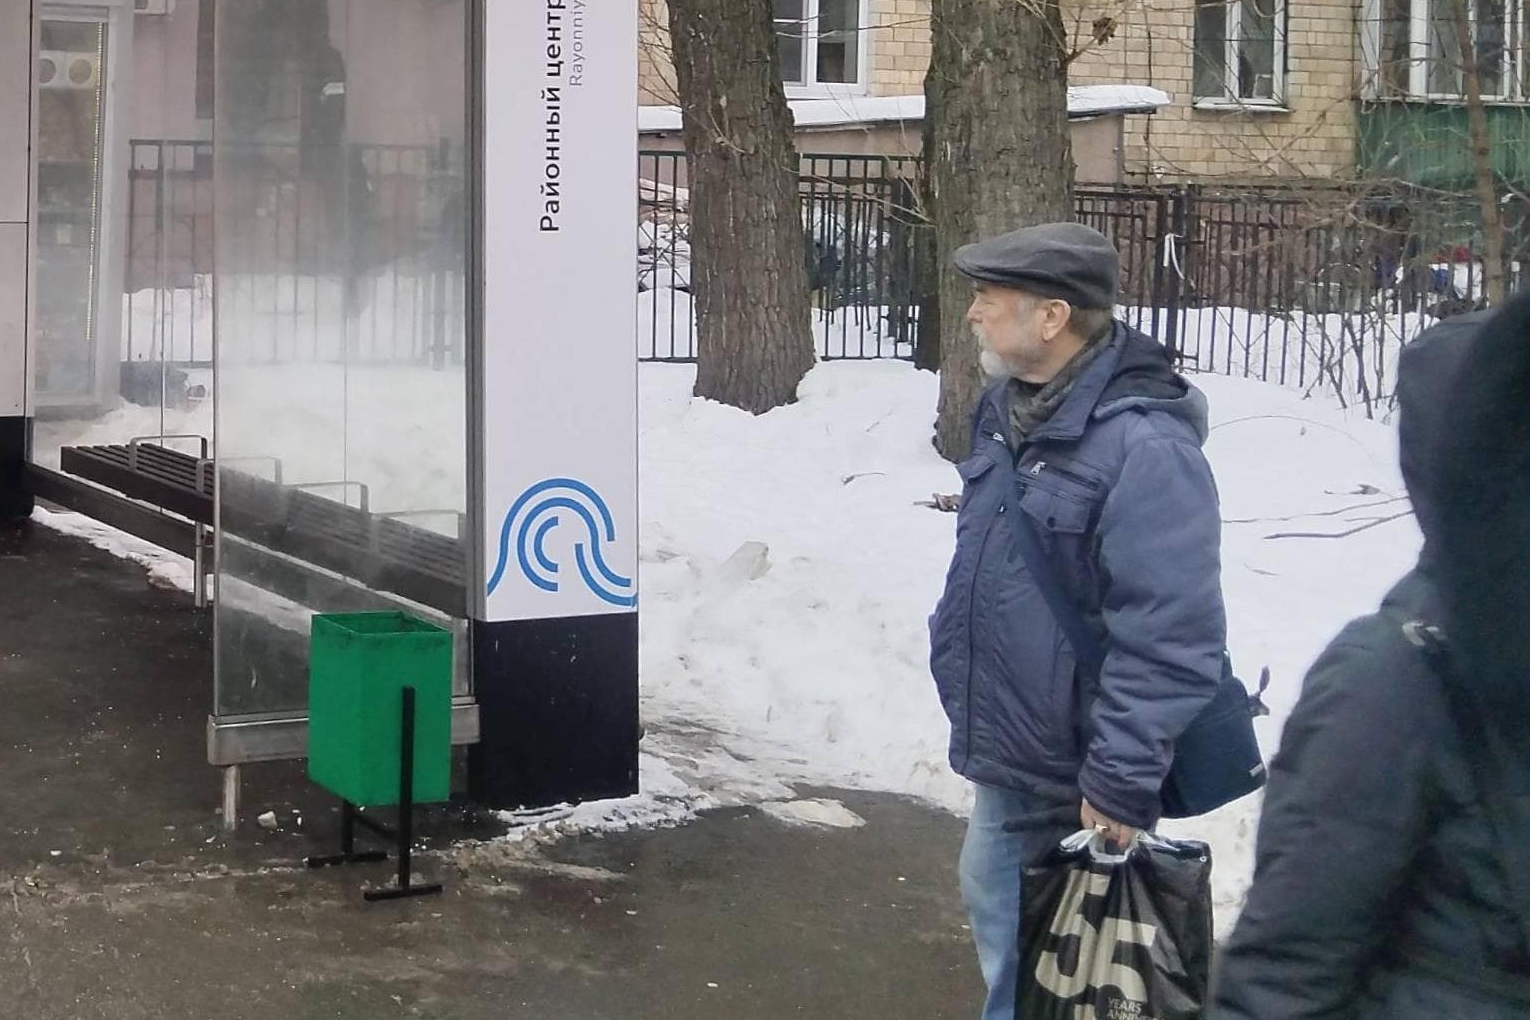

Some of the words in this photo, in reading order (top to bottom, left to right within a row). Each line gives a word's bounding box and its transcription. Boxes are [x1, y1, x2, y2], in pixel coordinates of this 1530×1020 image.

[569, 0, 586, 86] Rayonniy
[540, 87, 561, 231] Районный
[1108, 996, 1142, 1014] YEARS
